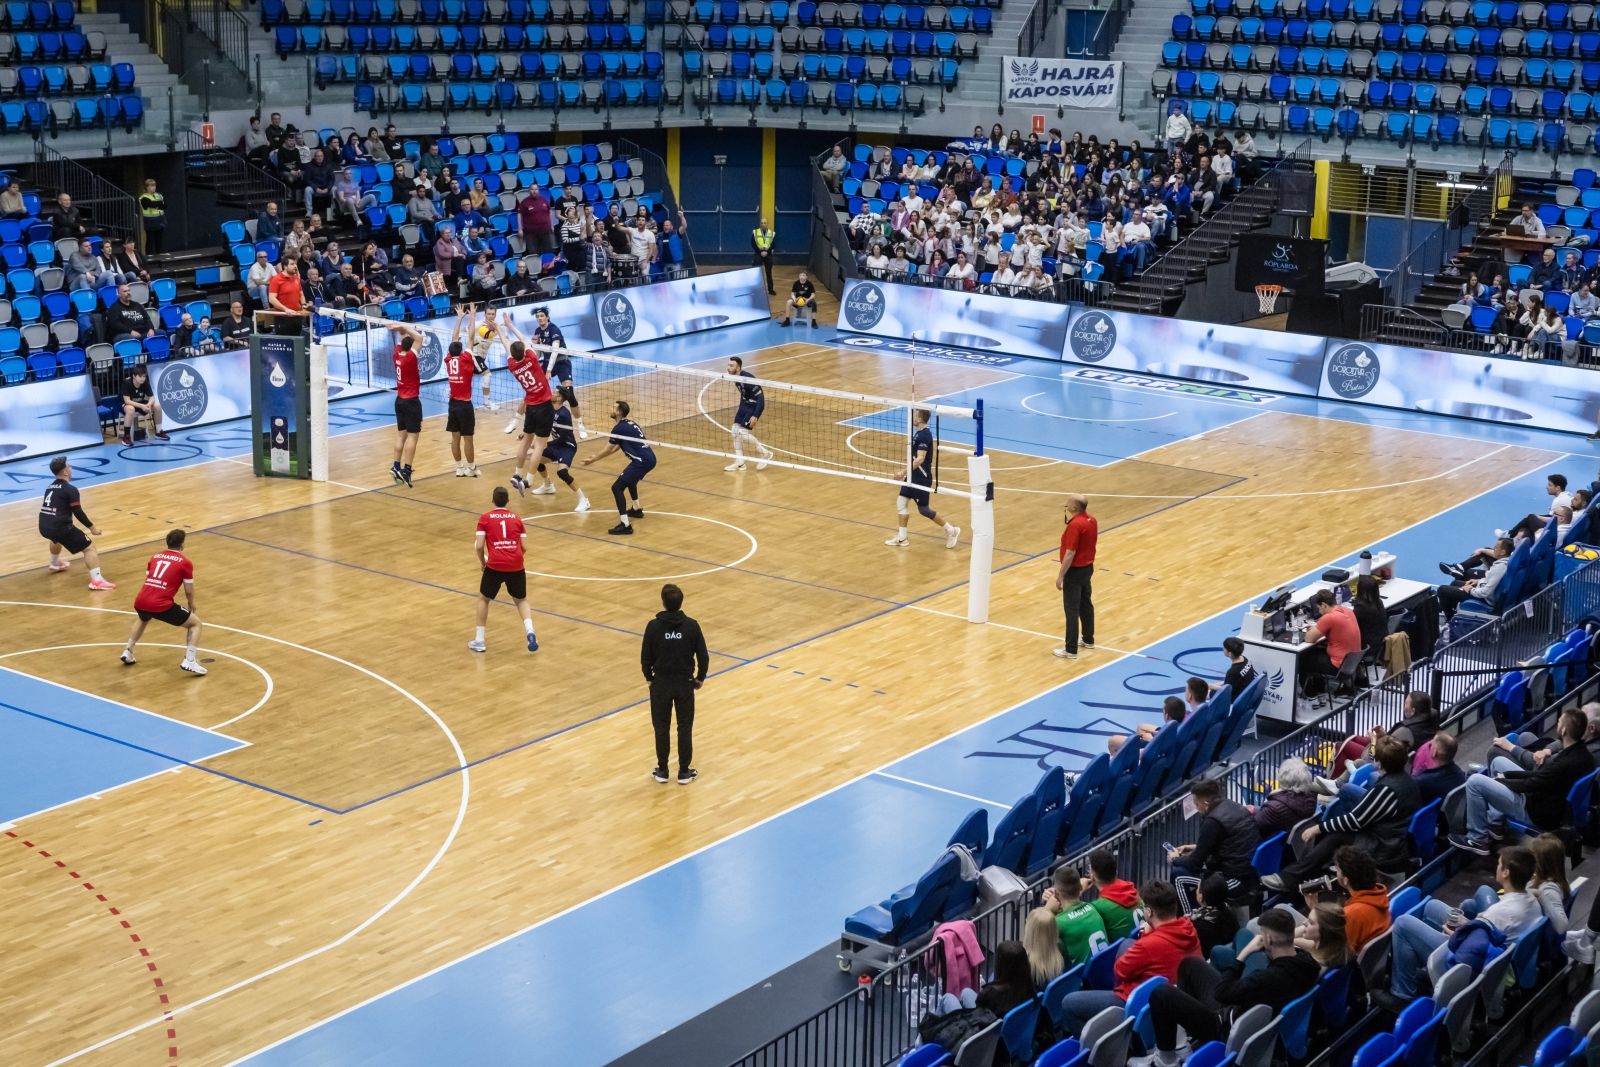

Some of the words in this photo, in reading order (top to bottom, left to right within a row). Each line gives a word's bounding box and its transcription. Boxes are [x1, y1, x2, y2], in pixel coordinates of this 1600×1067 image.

[1041, 63, 1115, 80] HAJRÁ
[1007, 82, 1114, 99] KAPOSVÁR!
[396, 367, 402, 381] 9
[449, 358, 459, 375] 19
[518, 370, 536, 389] 33
[44, 490, 54, 507] 4
[499, 519, 507, 539] 1
[152, 560, 172, 579] 17
[664, 630, 683, 640] DÁG
